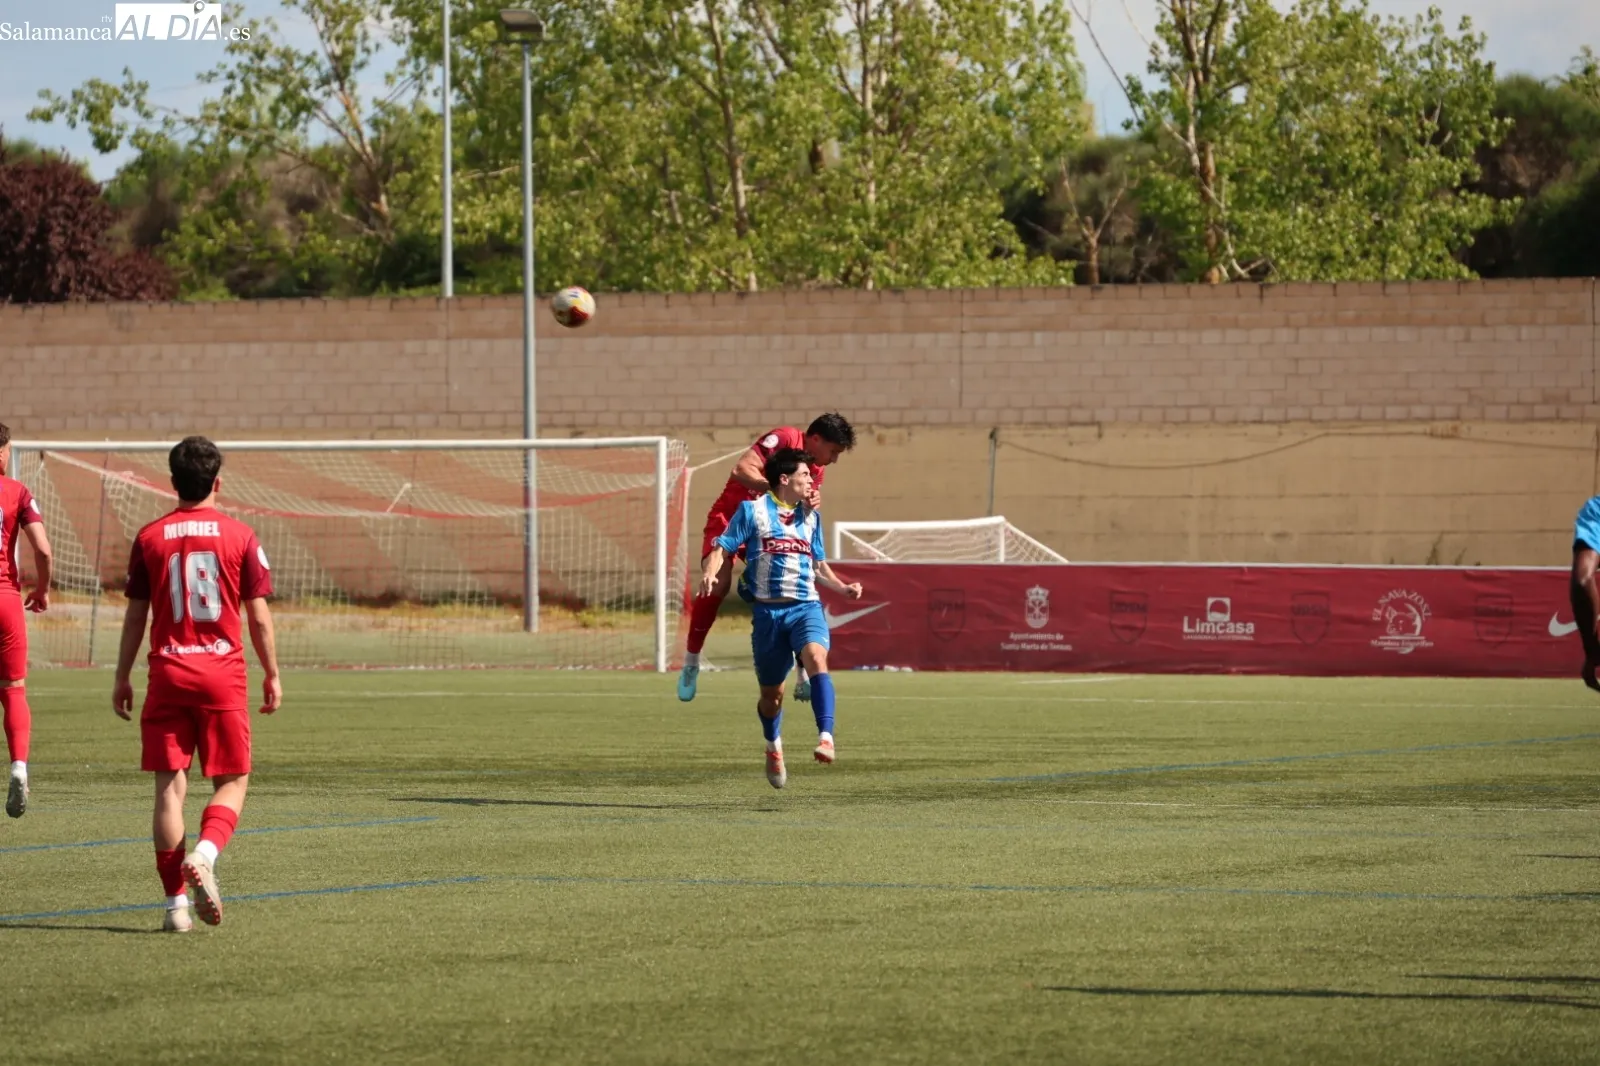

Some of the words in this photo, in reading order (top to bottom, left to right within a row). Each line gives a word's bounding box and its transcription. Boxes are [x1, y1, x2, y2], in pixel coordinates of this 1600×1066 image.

[164, 520, 220, 540] MURIEL
[168, 550, 222, 624] 18
[1183, 615, 1255, 634] Limcasa
